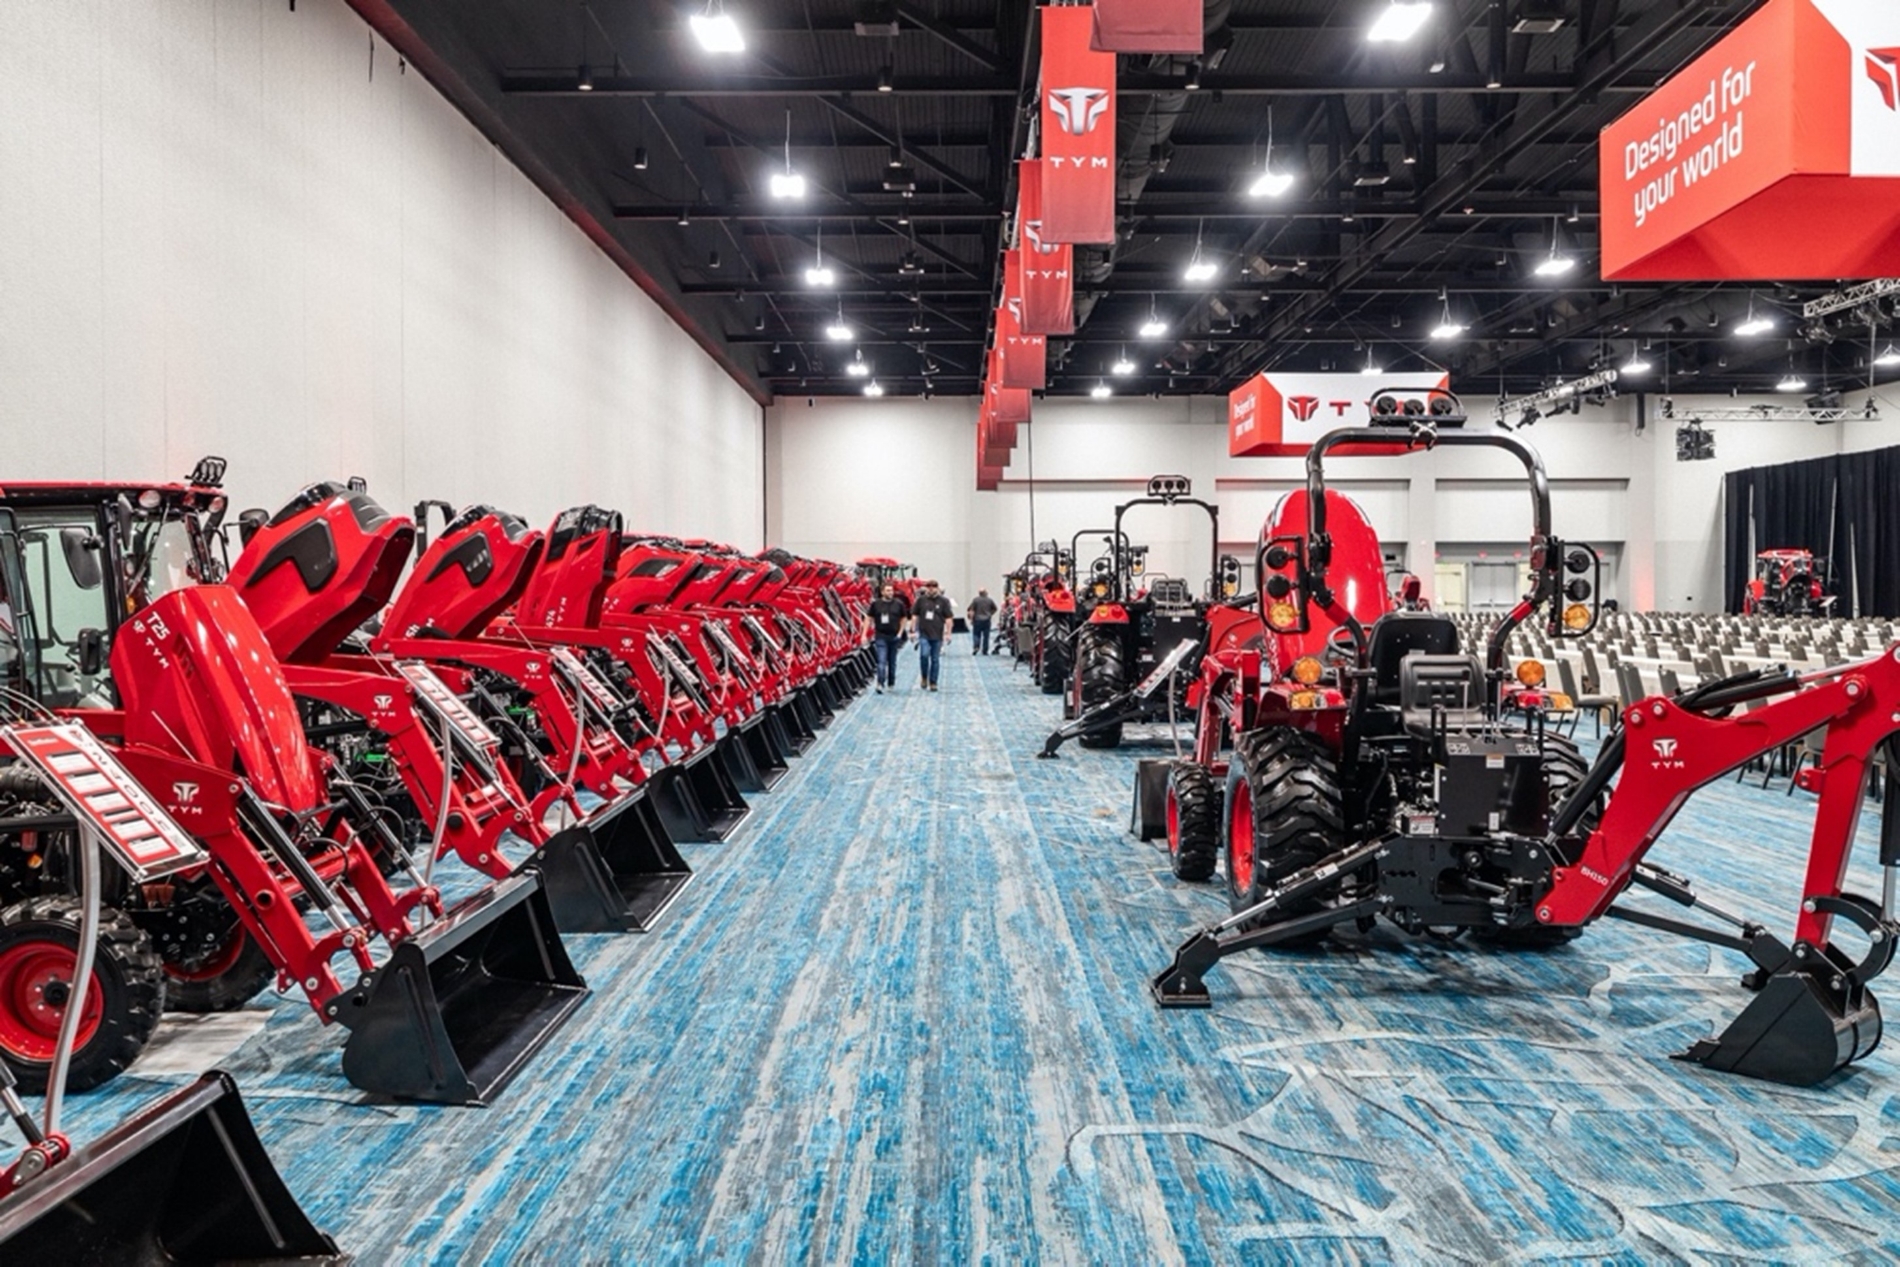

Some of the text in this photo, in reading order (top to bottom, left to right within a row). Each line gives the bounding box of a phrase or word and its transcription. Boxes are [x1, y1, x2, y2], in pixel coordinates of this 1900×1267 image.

[1625, 61, 1756, 181] Designed for
[1050, 156, 1108, 168] TYM
[1634, 110, 1743, 228] your world
[1025, 270, 1068, 279] TYM
[1008, 337, 1042, 345] TYM
[147, 611, 171, 641] T25
[145, 636, 170, 670] TYM
[1651, 761, 1685, 769] TYM
[168, 805, 203, 815] TYM
[1580, 865, 1610, 887] BH150
